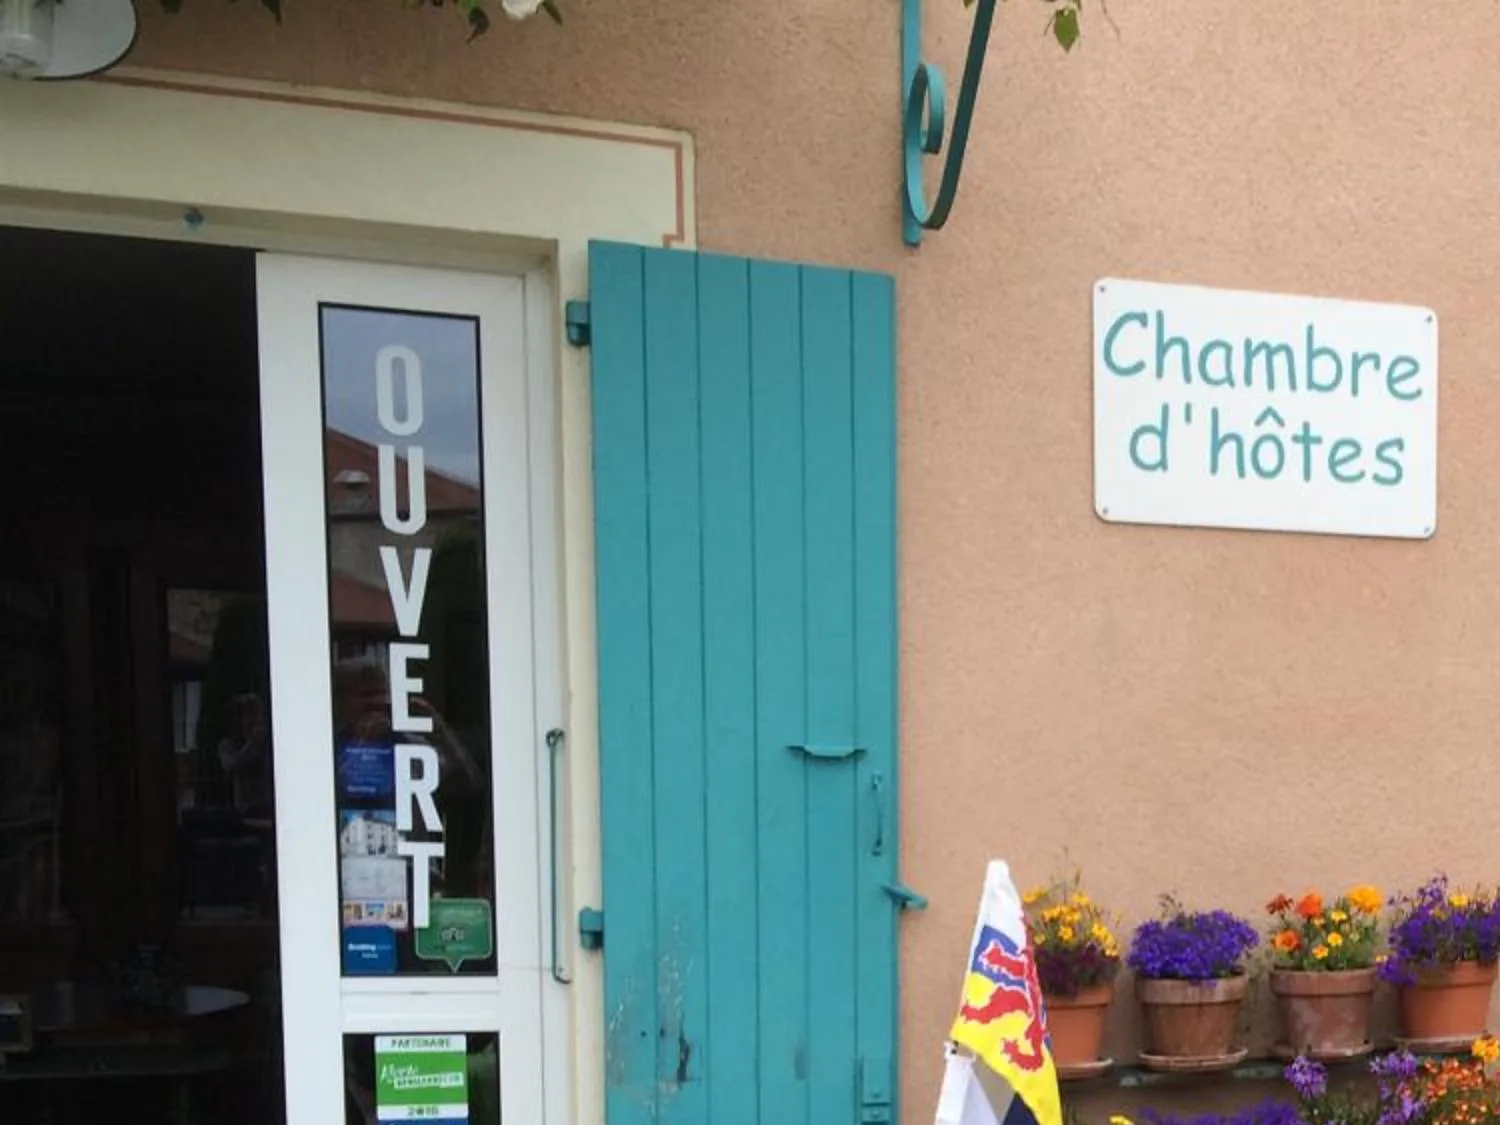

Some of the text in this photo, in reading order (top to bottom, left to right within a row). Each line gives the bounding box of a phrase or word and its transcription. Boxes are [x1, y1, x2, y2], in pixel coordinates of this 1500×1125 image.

[1103, 310, 1423, 401] Chambre
[1129, 402, 1405, 486] d'hôtes
[375, 344, 445, 928] OUVERT
